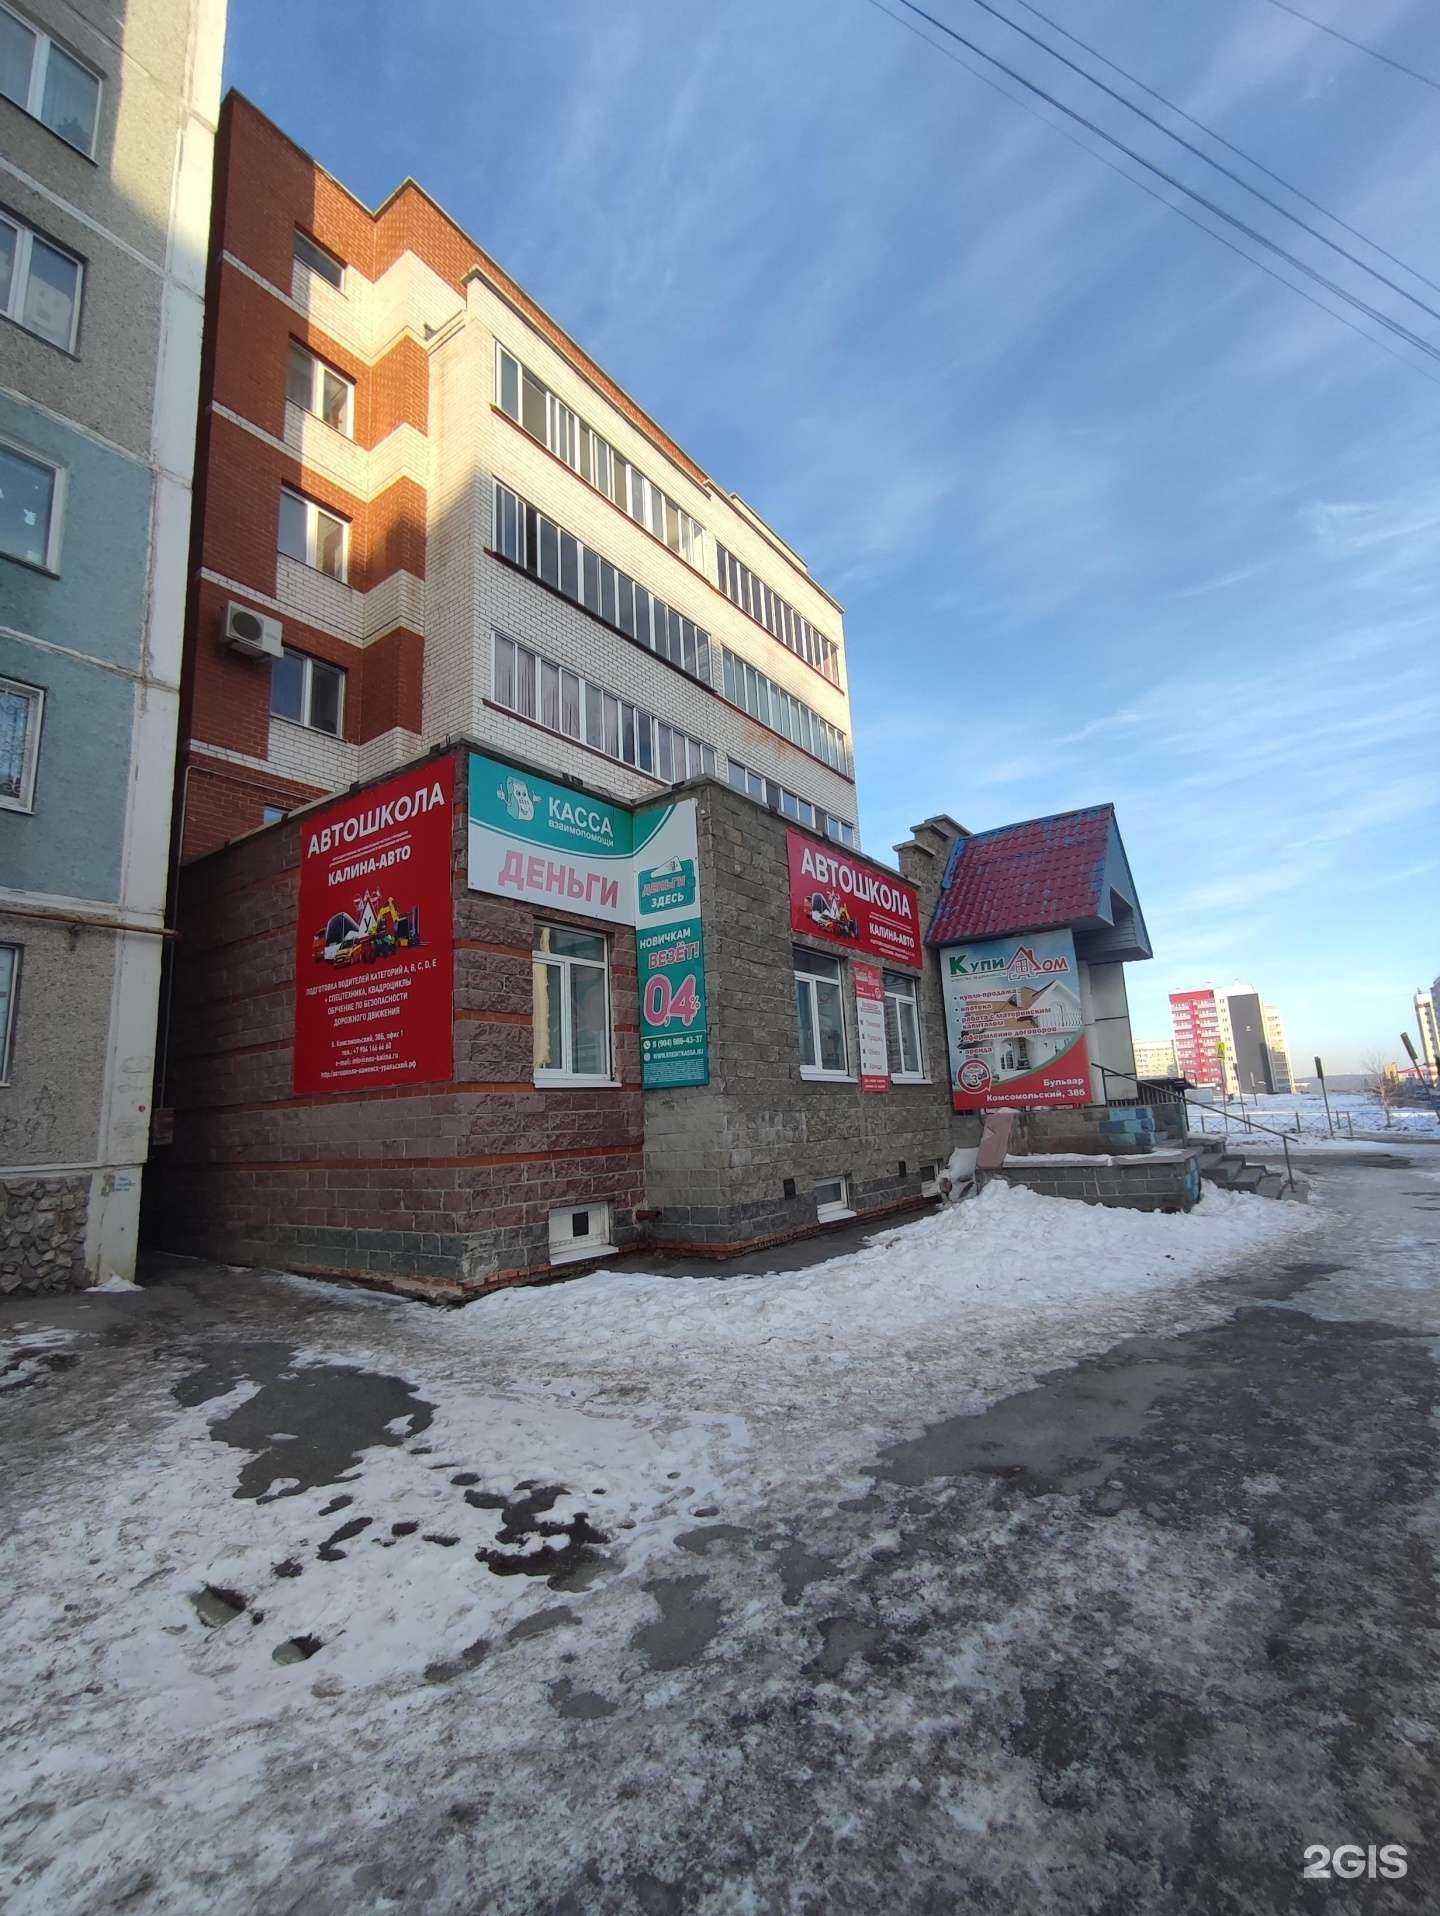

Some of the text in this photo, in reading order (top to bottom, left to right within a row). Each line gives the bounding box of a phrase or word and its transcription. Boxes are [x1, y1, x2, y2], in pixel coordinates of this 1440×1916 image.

[307, 782, 445, 859] АВТОШКОЛА
[548, 796, 614, 837] КАССА
[548, 820, 614, 848] взаимопомощи
[328, 845, 411, 886] КАЛИНА-АВТО
[497, 849, 619, 909] ДЕНЬГИ
[641, 875, 686, 898] ДЕНЬГИ
[801, 847, 912, 920] АВТОШКОЛА
[651, 892, 685, 908] ЗДЕСЬ
[640, 928, 691, 949] НОВИЧКАМ
[869, 921, 915, 949] КАЛИНА-АВТО
[648, 941, 700, 969] ВЕЗЁТ!
[306, 982, 337, 996] ПОДГОТОВКА
[338, 972, 369, 990] ВОДИТЕЛЕЙ
[370, 965, 403, 980] КАТЕГОРИЙ
[368, 978, 412, 994] КВАДРОЦИКЛЫ
[328, 992, 408, 1015] ОБУЧЕНИЕ ПО БЕЗОПАСНОСТИ
[333, 1007, 400, 1027] ДОРОЖНОГО ДВИЖЕНИЯ
[986, 1090, 1065, 1103] Комсомольский,
[1043, 1077, 1084, 1090] Бульвар
